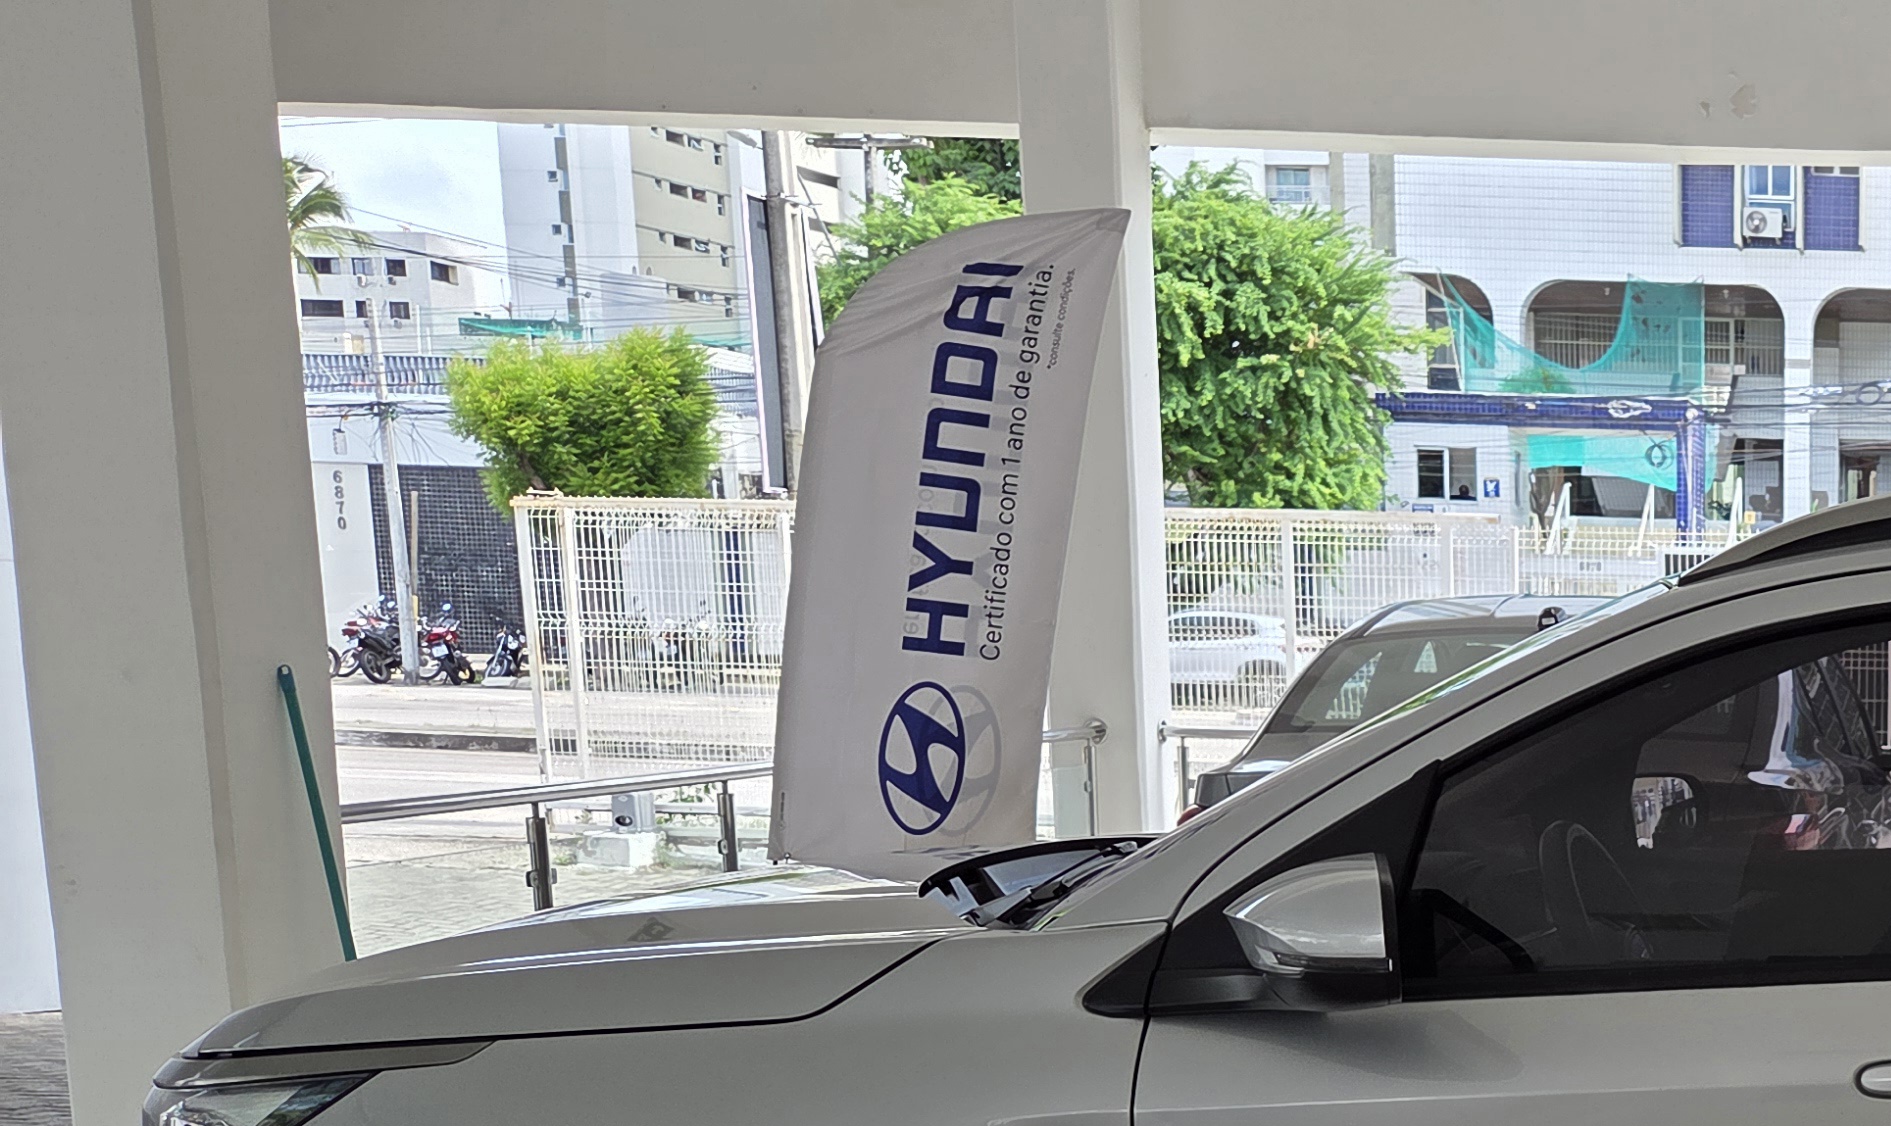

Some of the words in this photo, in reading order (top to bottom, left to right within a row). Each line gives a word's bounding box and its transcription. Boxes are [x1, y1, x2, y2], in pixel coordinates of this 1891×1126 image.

[1019, 264, 1054, 364] garantia.
[1009, 370, 1032, 400] de
[1007, 407, 1027, 450] ano
[902, 262, 1024, 656] HYUNDAI
[1001, 457, 1021, 465] 1
[332, 470, 347, 530] 6870
[998, 473, 1019, 525] com
[979, 531, 1013, 661] Certificado
